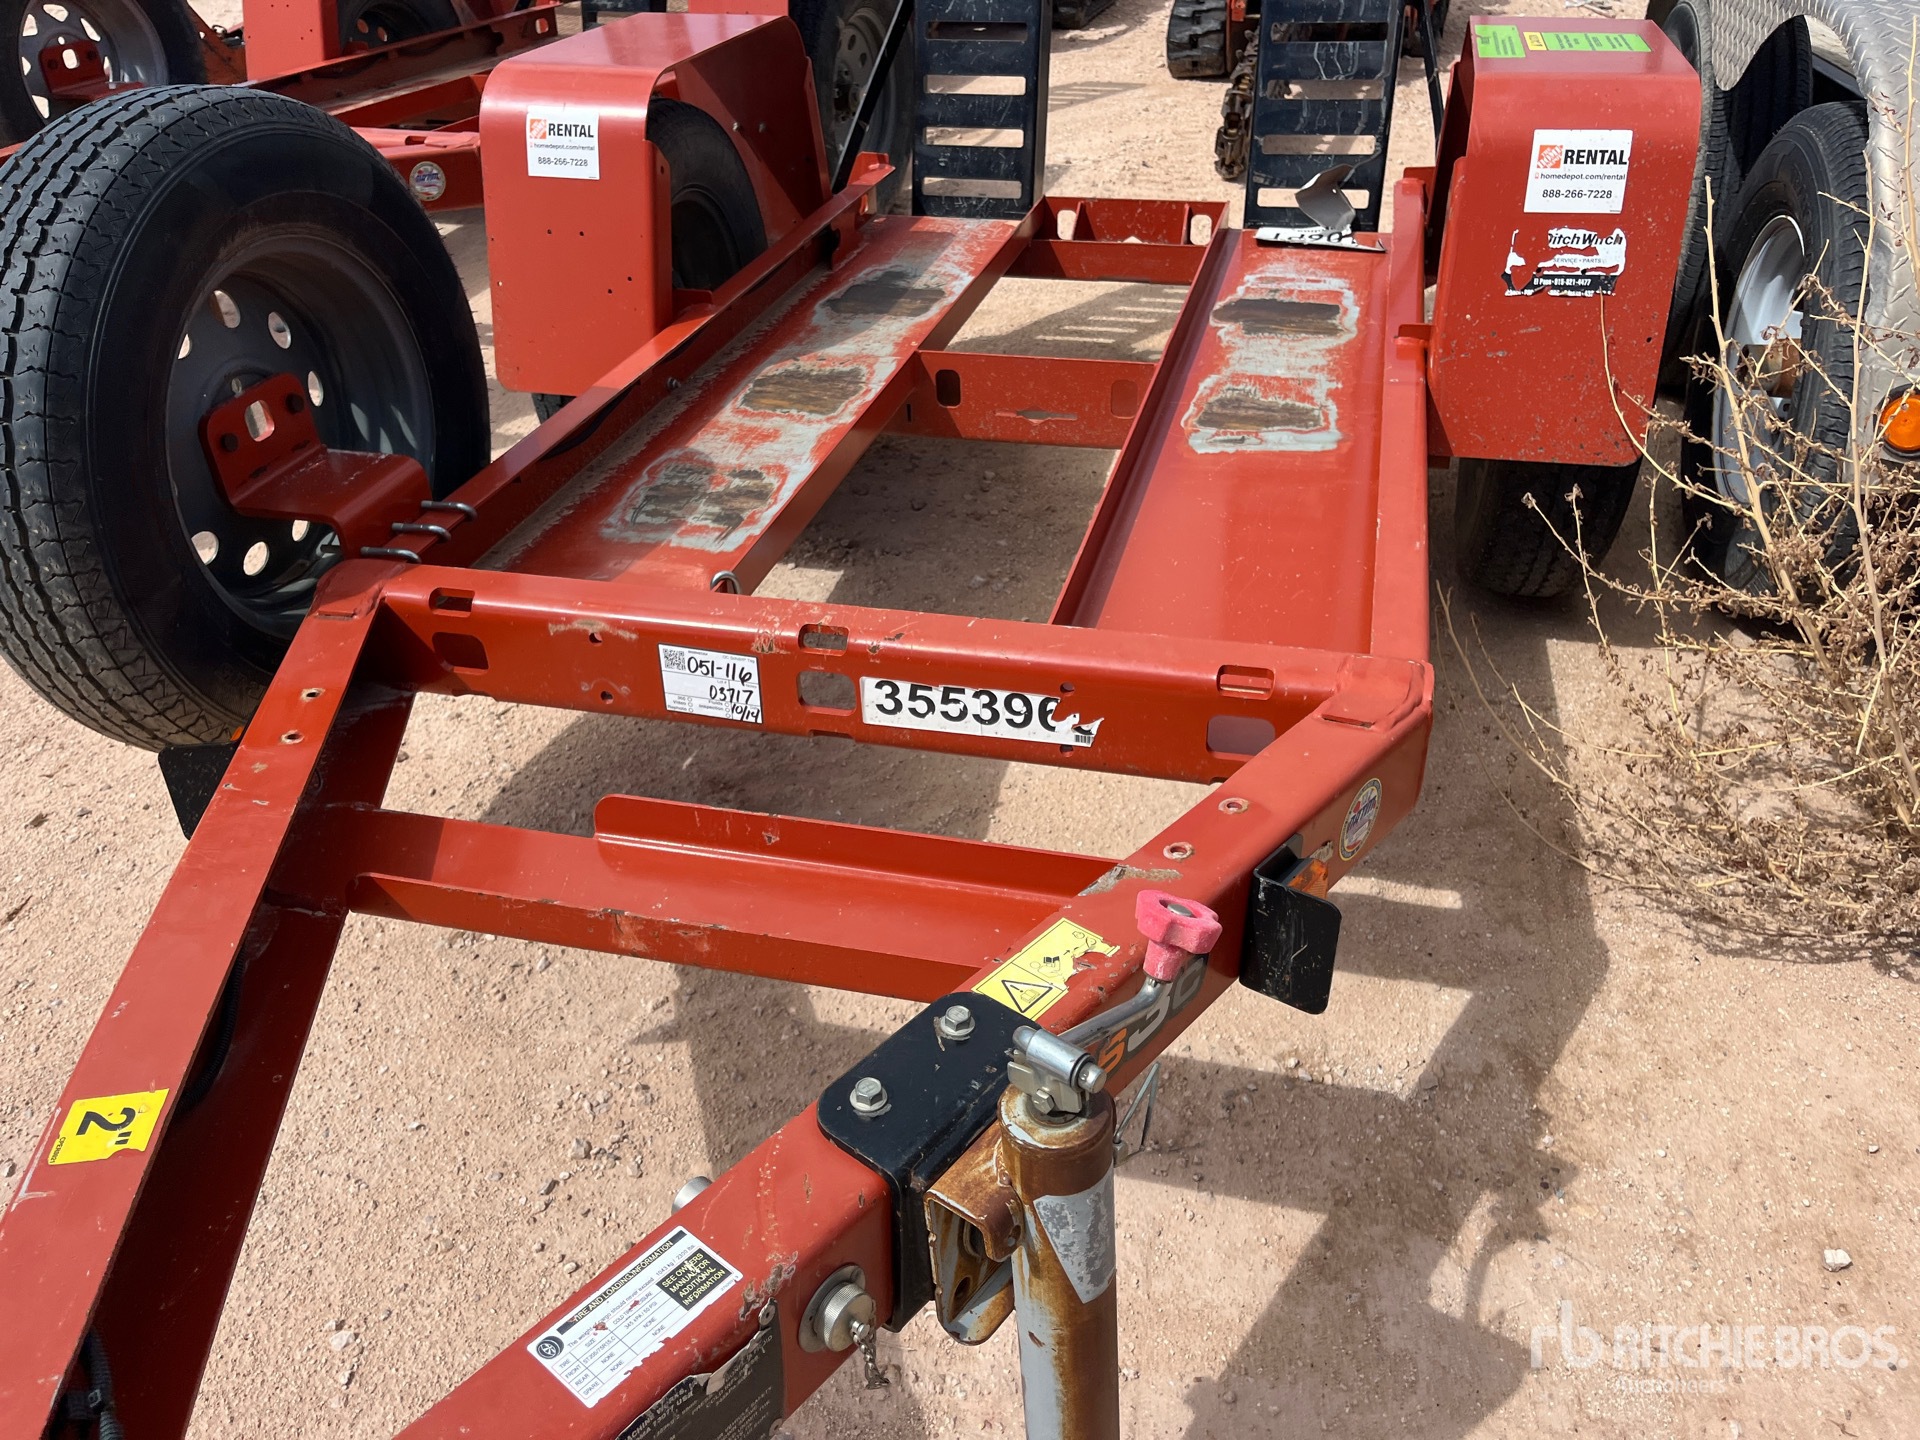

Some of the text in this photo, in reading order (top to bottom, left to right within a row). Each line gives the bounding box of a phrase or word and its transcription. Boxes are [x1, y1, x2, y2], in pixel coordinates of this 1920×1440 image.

[548, 123, 594, 138] RENTAL
[534, 143, 595, 151] homedepot.com/rental
[538, 156, 588, 167] 888-266-7228
[1563, 149, 1627, 165] RENTAL
[1542, 189, 1612, 199] 888-266-7228
[687, 656, 752, 686] 051-116
[709, 684, 754, 705] 03717
[586, 1295, 604, 1310] AND
[601, 1271, 634, 1299] LOADING
[629, 1240, 673, 1276] INFORMATION
[661, 1274, 677, 1288] SEE
[669, 1268, 697, 1293] MANUAL
[694, 1258, 710, 1271] FOR
[678, 1264, 716, 1298] ADDITIONAL
[682, 1268, 726, 1306] INFORMATION
[567, 1338, 578, 1348] The
[576, 1325, 595, 1341] weight
[609, 1299, 627, 1314] should
[624, 1289, 639, 1302] never
[637, 1276, 655, 1291] exceed
[655, 1265, 669, 1276] 1043
[612, 1314, 625, 1325] COLD
[641, 1315, 657, 1329] NONE
[650, 1323, 666, 1337] NONE
[584, 1337, 596, 1347] SIZE
[558, 1358, 570, 1368] TIRE
[600, 1351, 615, 1364] NONE
[564, 1363, 582, 1378] FRONT
[609, 1359, 624, 1372] NONE
[574, 1372, 590, 1386] REAR
[582, 1380, 600, 1395] SPARE
